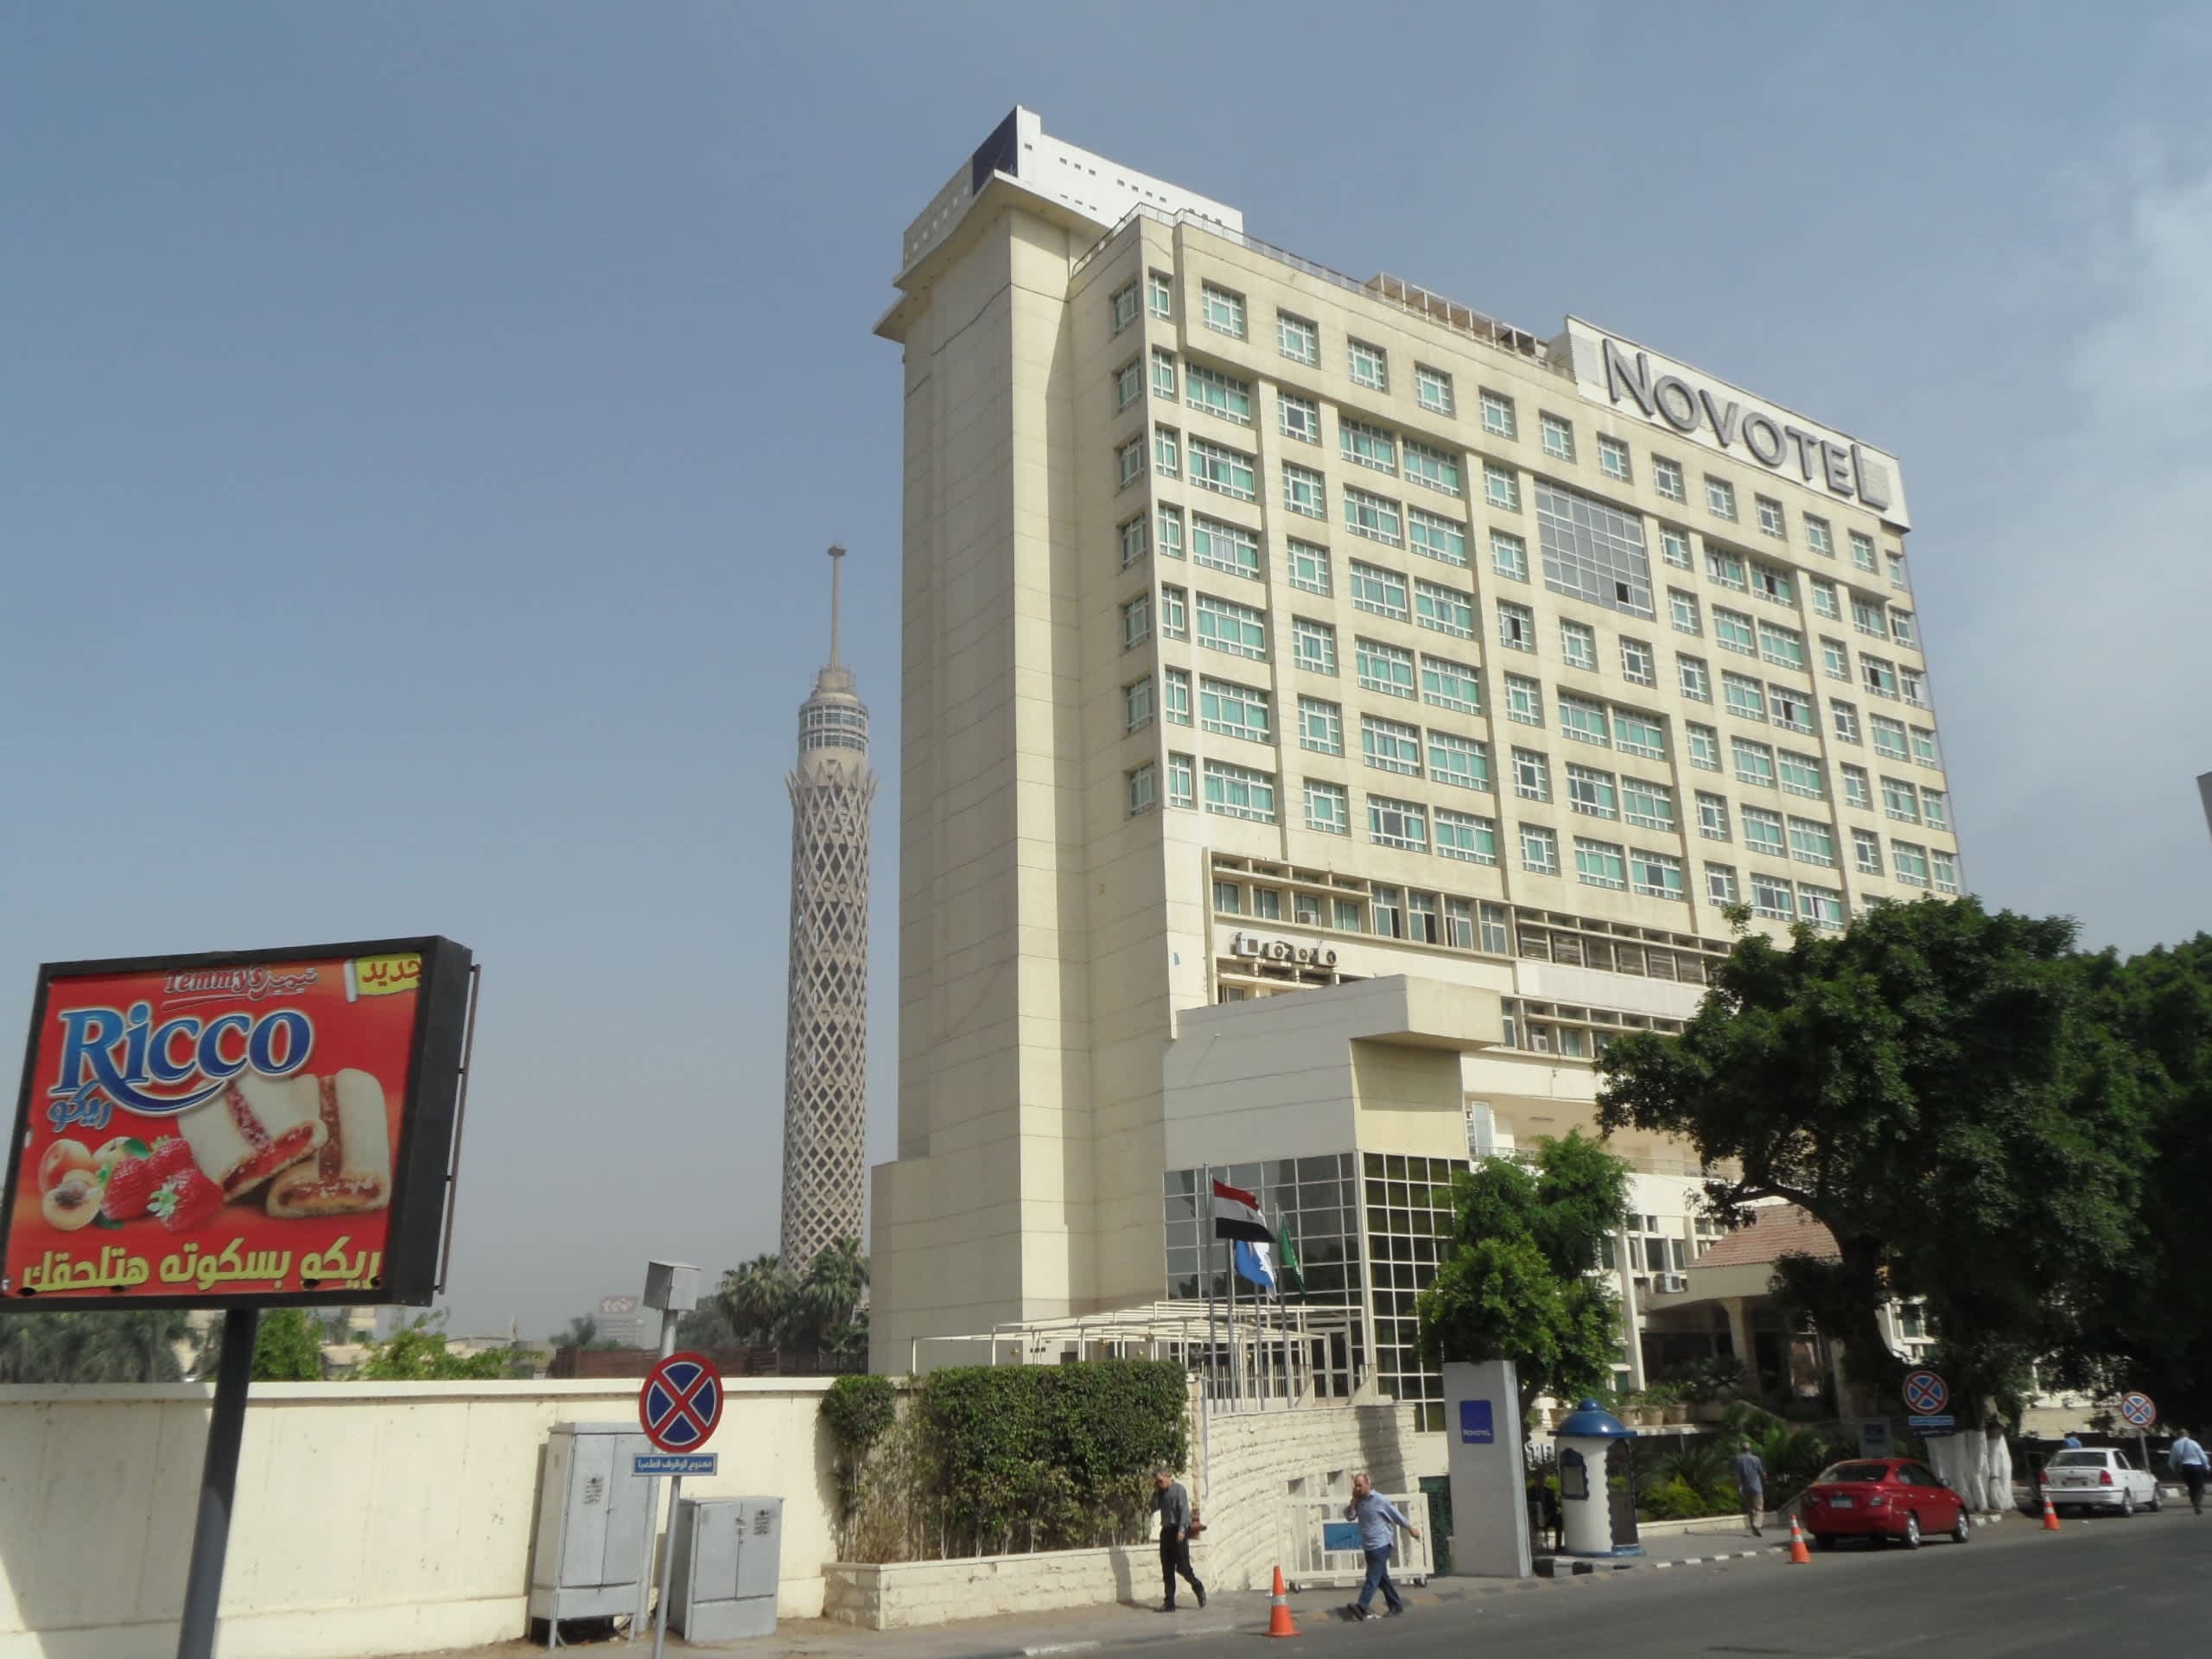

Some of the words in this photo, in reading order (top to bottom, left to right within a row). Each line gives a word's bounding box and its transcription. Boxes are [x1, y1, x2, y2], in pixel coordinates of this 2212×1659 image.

[1602, 337, 1891, 512] NOVOTEL
[48, 1080, 113, 1134] ريكو
[160, 1237, 292, 1292] بسكوته
